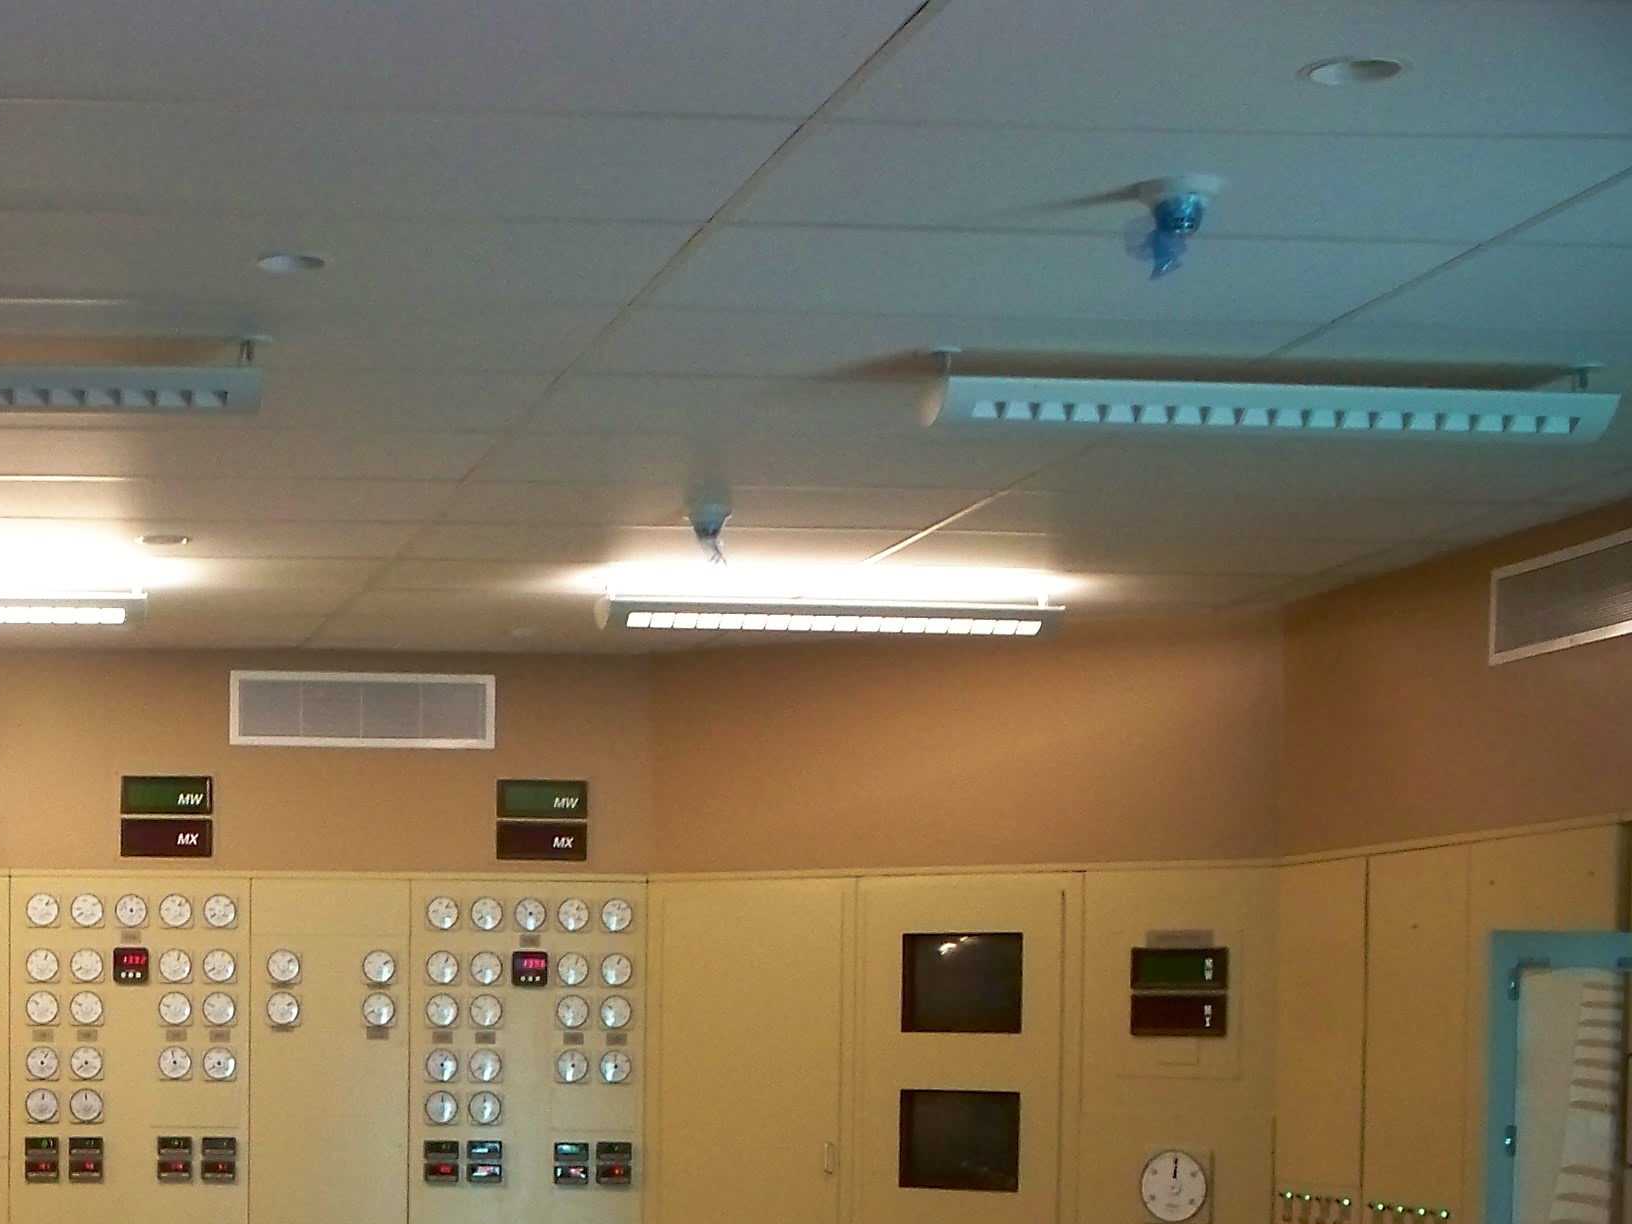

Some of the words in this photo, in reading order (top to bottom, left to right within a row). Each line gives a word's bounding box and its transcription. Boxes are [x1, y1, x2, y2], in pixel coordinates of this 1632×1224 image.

[177, 793, 204, 806] MW
[553, 797, 579, 809] MW
[176, 833, 200, 846] MX
[552, 836, 574, 849] MX
